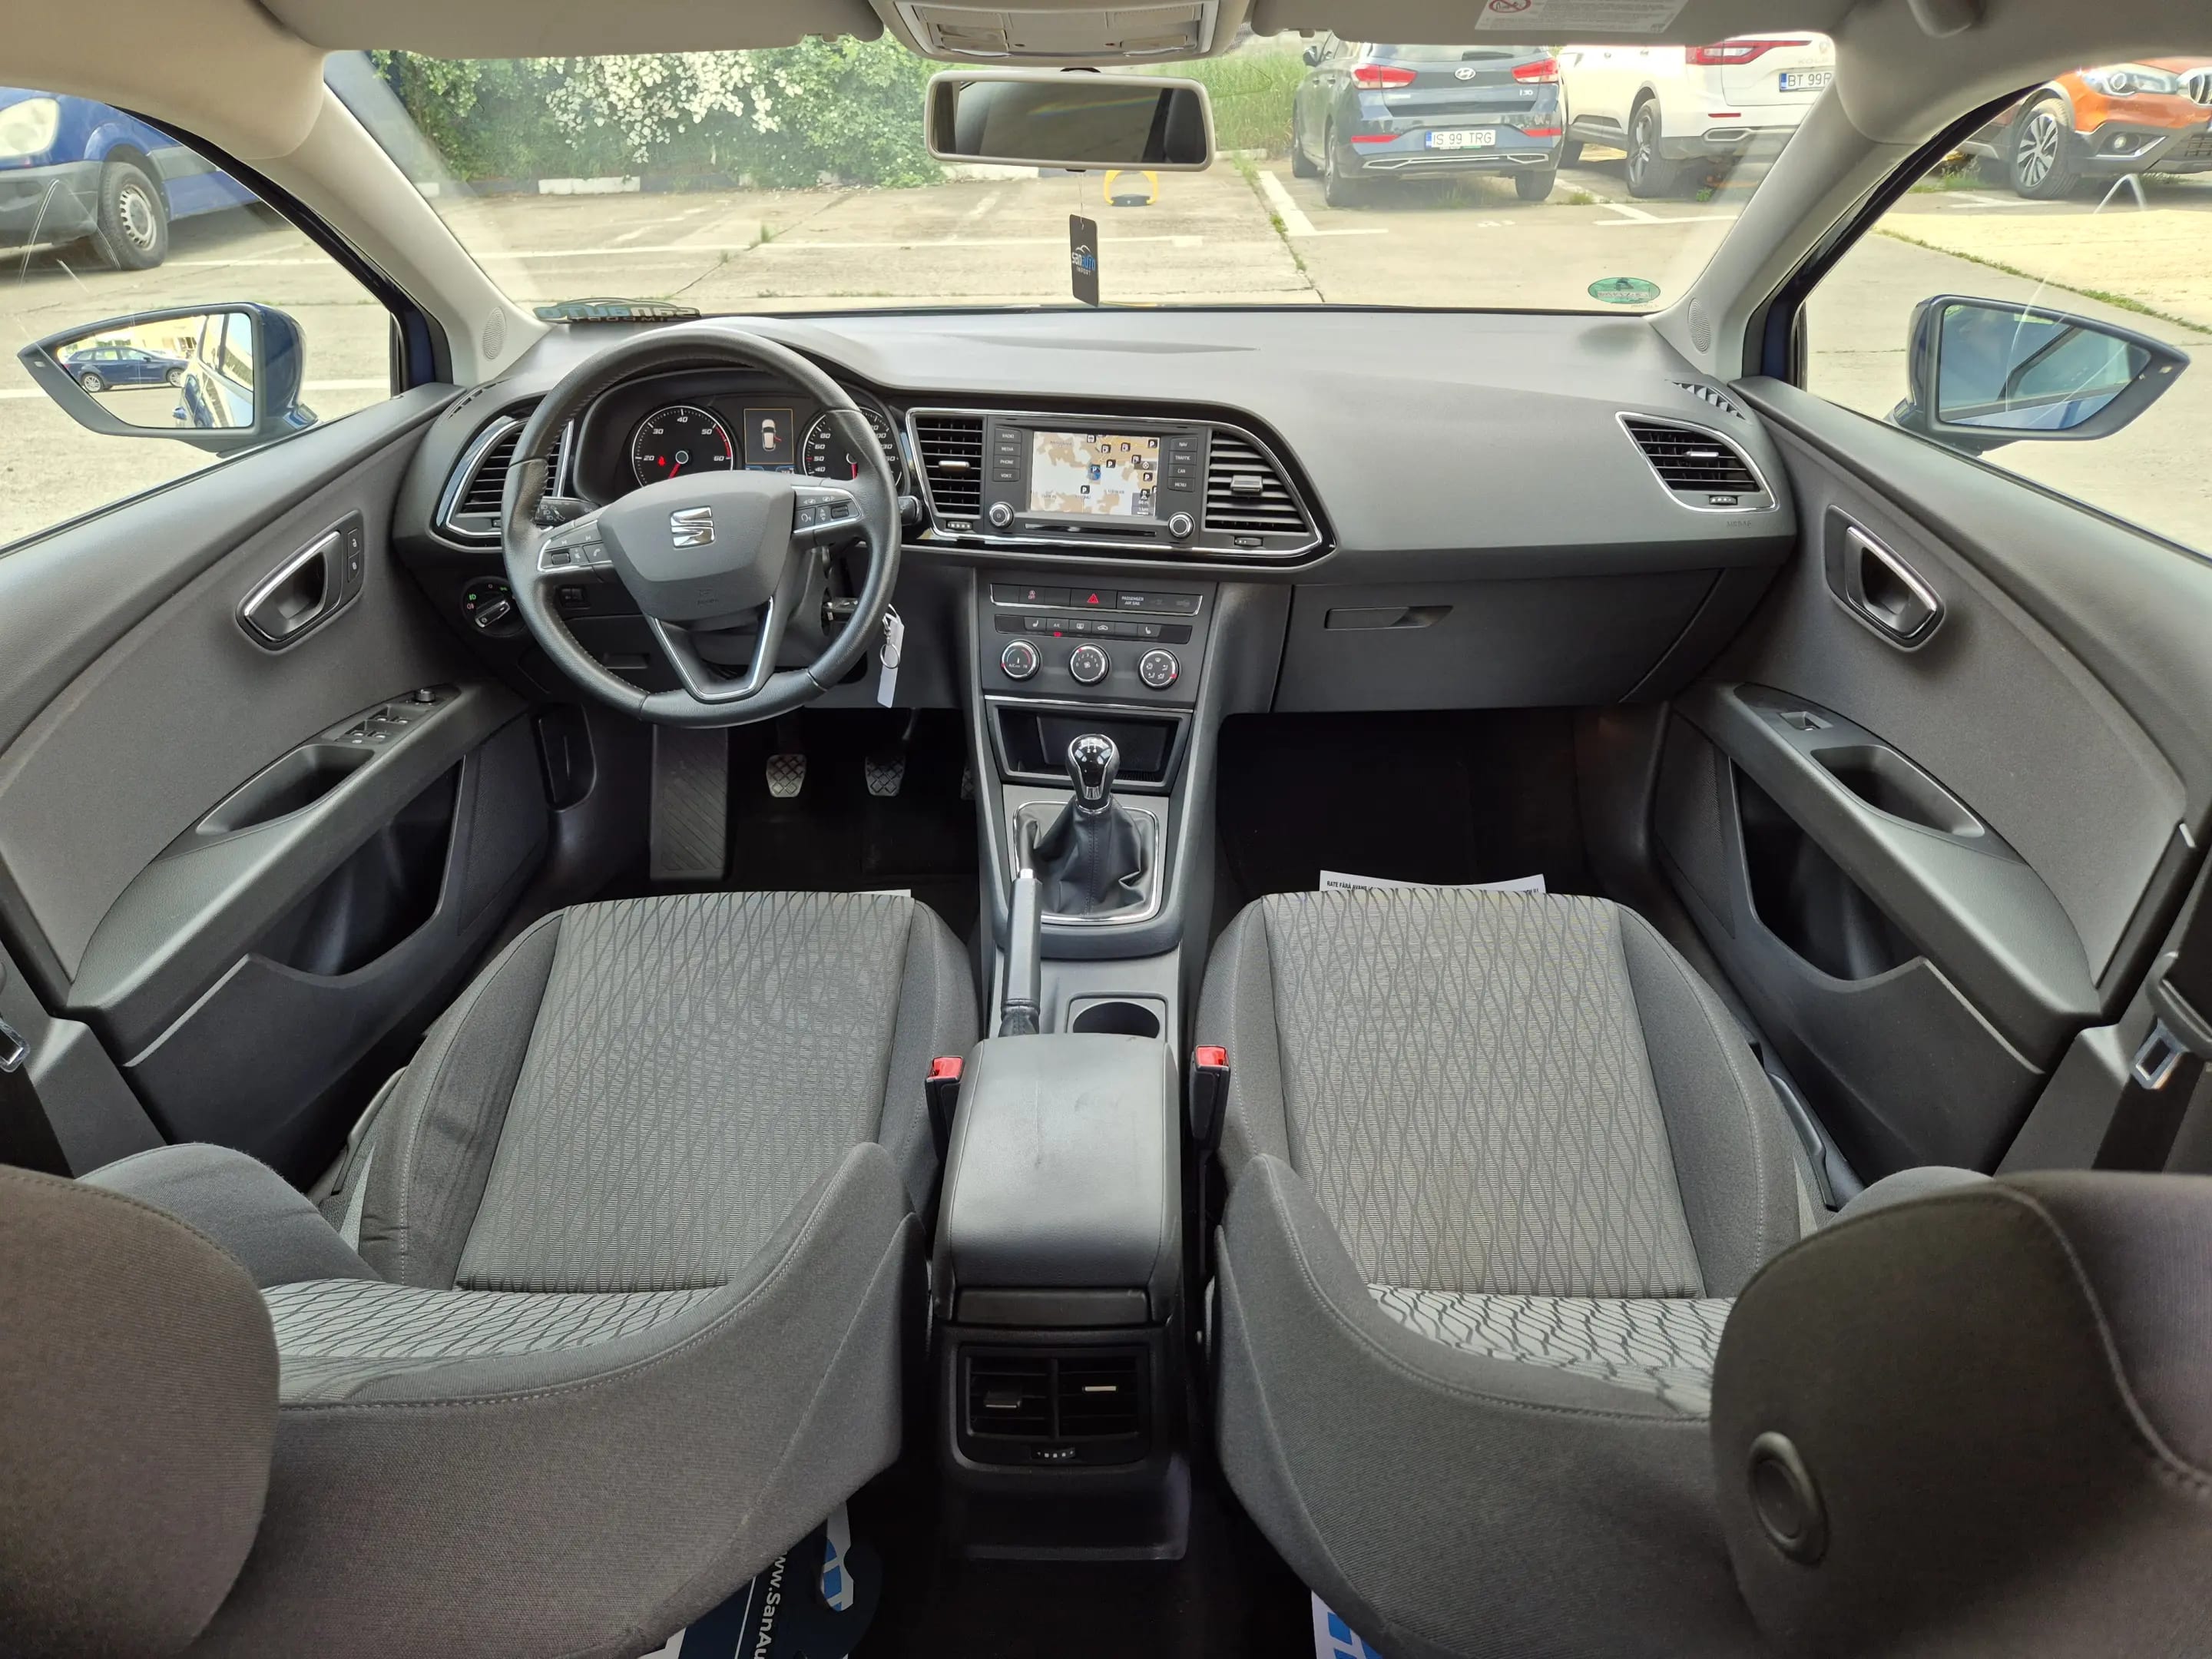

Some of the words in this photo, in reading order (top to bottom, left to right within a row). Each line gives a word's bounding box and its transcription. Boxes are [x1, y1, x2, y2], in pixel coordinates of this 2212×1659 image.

[1788, 74, 1803, 87] BT
[1433, 134, 1444, 145] IS
[1449, 133, 1462, 144] 99
[1469, 132, 1492, 144] TRG
